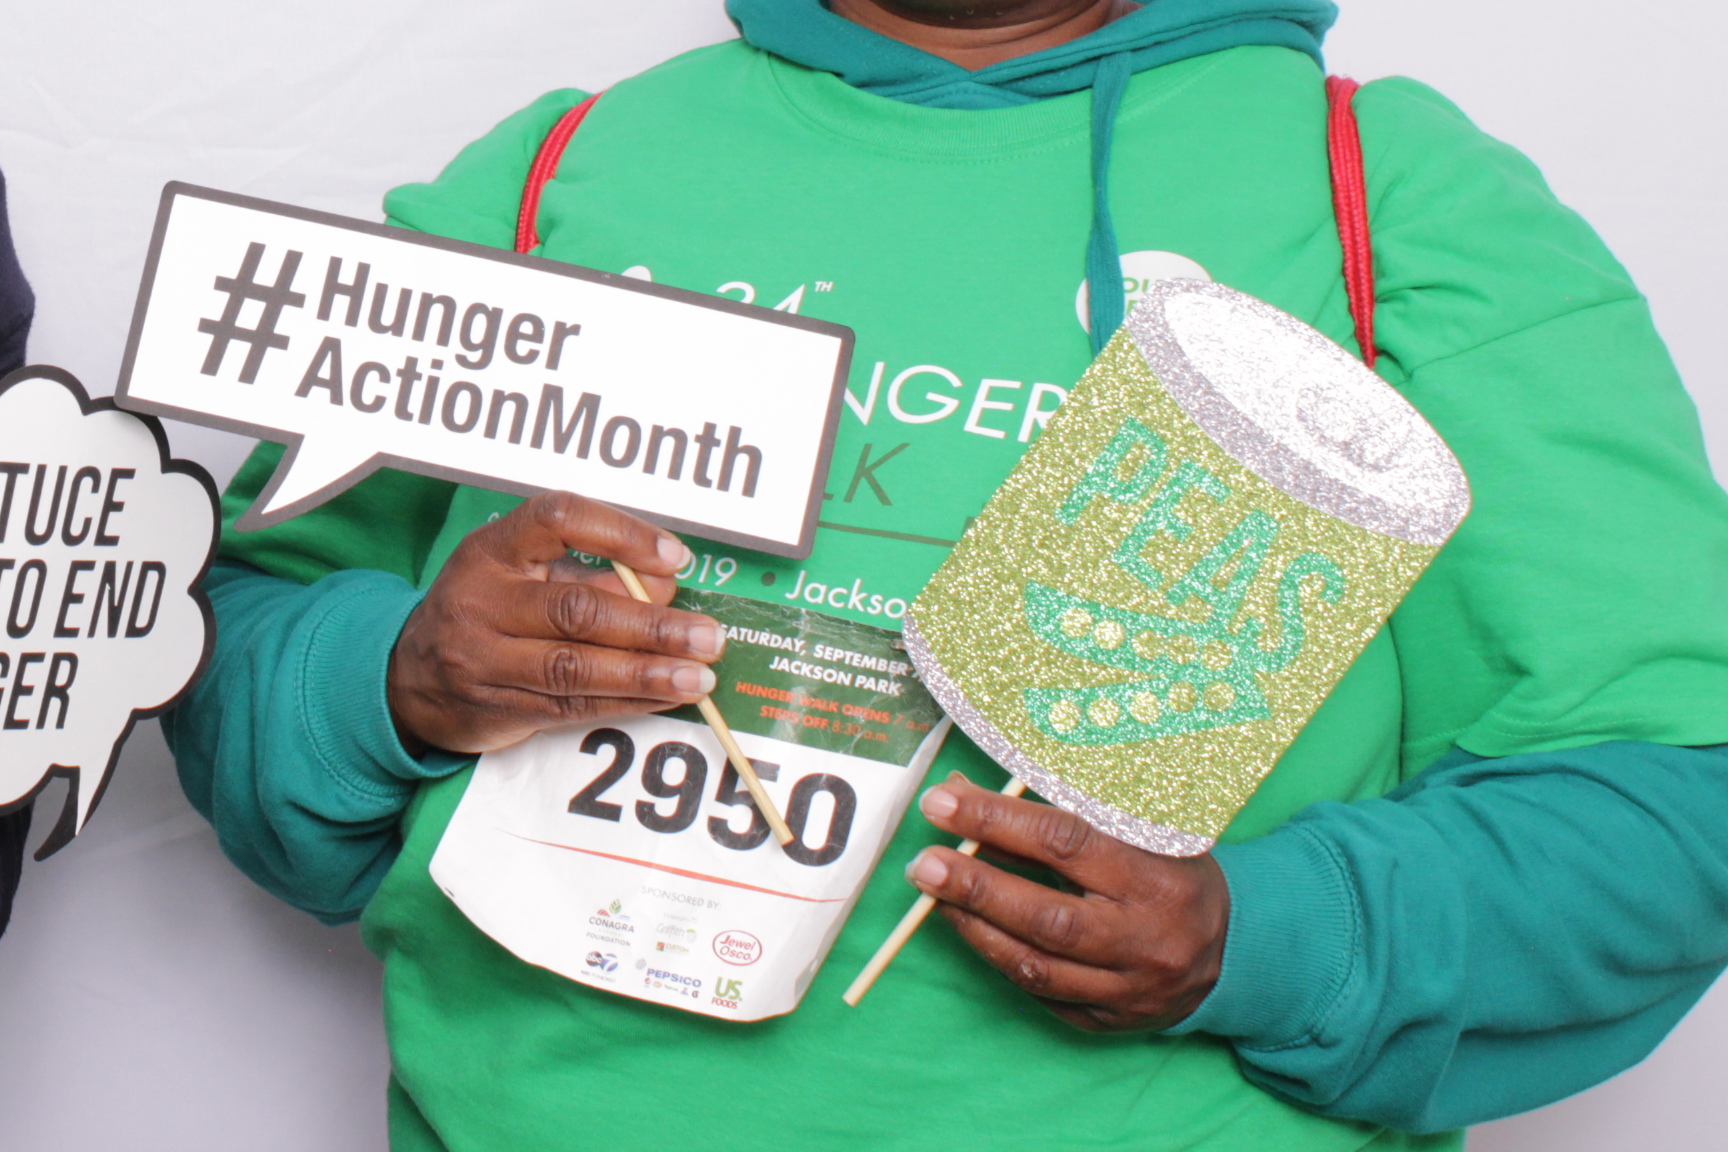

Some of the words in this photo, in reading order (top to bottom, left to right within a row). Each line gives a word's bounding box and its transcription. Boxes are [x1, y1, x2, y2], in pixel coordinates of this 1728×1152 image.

[294, 335, 763, 499] ActionMonth
[844, 361, 1069, 444] NGER
[1055, 416, 1346, 673] PEAS
[53, 559, 167, 639] END
[785, 570, 908, 619] Jackso
[769, 655, 854, 687] JACKSON
[854, 674, 903, 697] PARK
[813, 644, 908, 677] SEPTEMBER
[735, 681, 796, 703] HUNGER
[798, 692, 840, 713] WALK
[842, 704, 891, 724] OPENS
[759, 705, 800, 724] STEPS
[802, 714, 830, 730] OFF
[831, 720, 863, 737] 8:30
[567, 727, 858, 867] 2950
[640, 885, 704, 907] SPONSORED
[585, 931, 631, 947] FOUNDATION
[588, 916, 635, 933] CONAGRA
[720, 934, 756, 951] Jewel
[646, 968, 702, 988] PEPSICO
[711, 997, 739, 1010] FOODS
